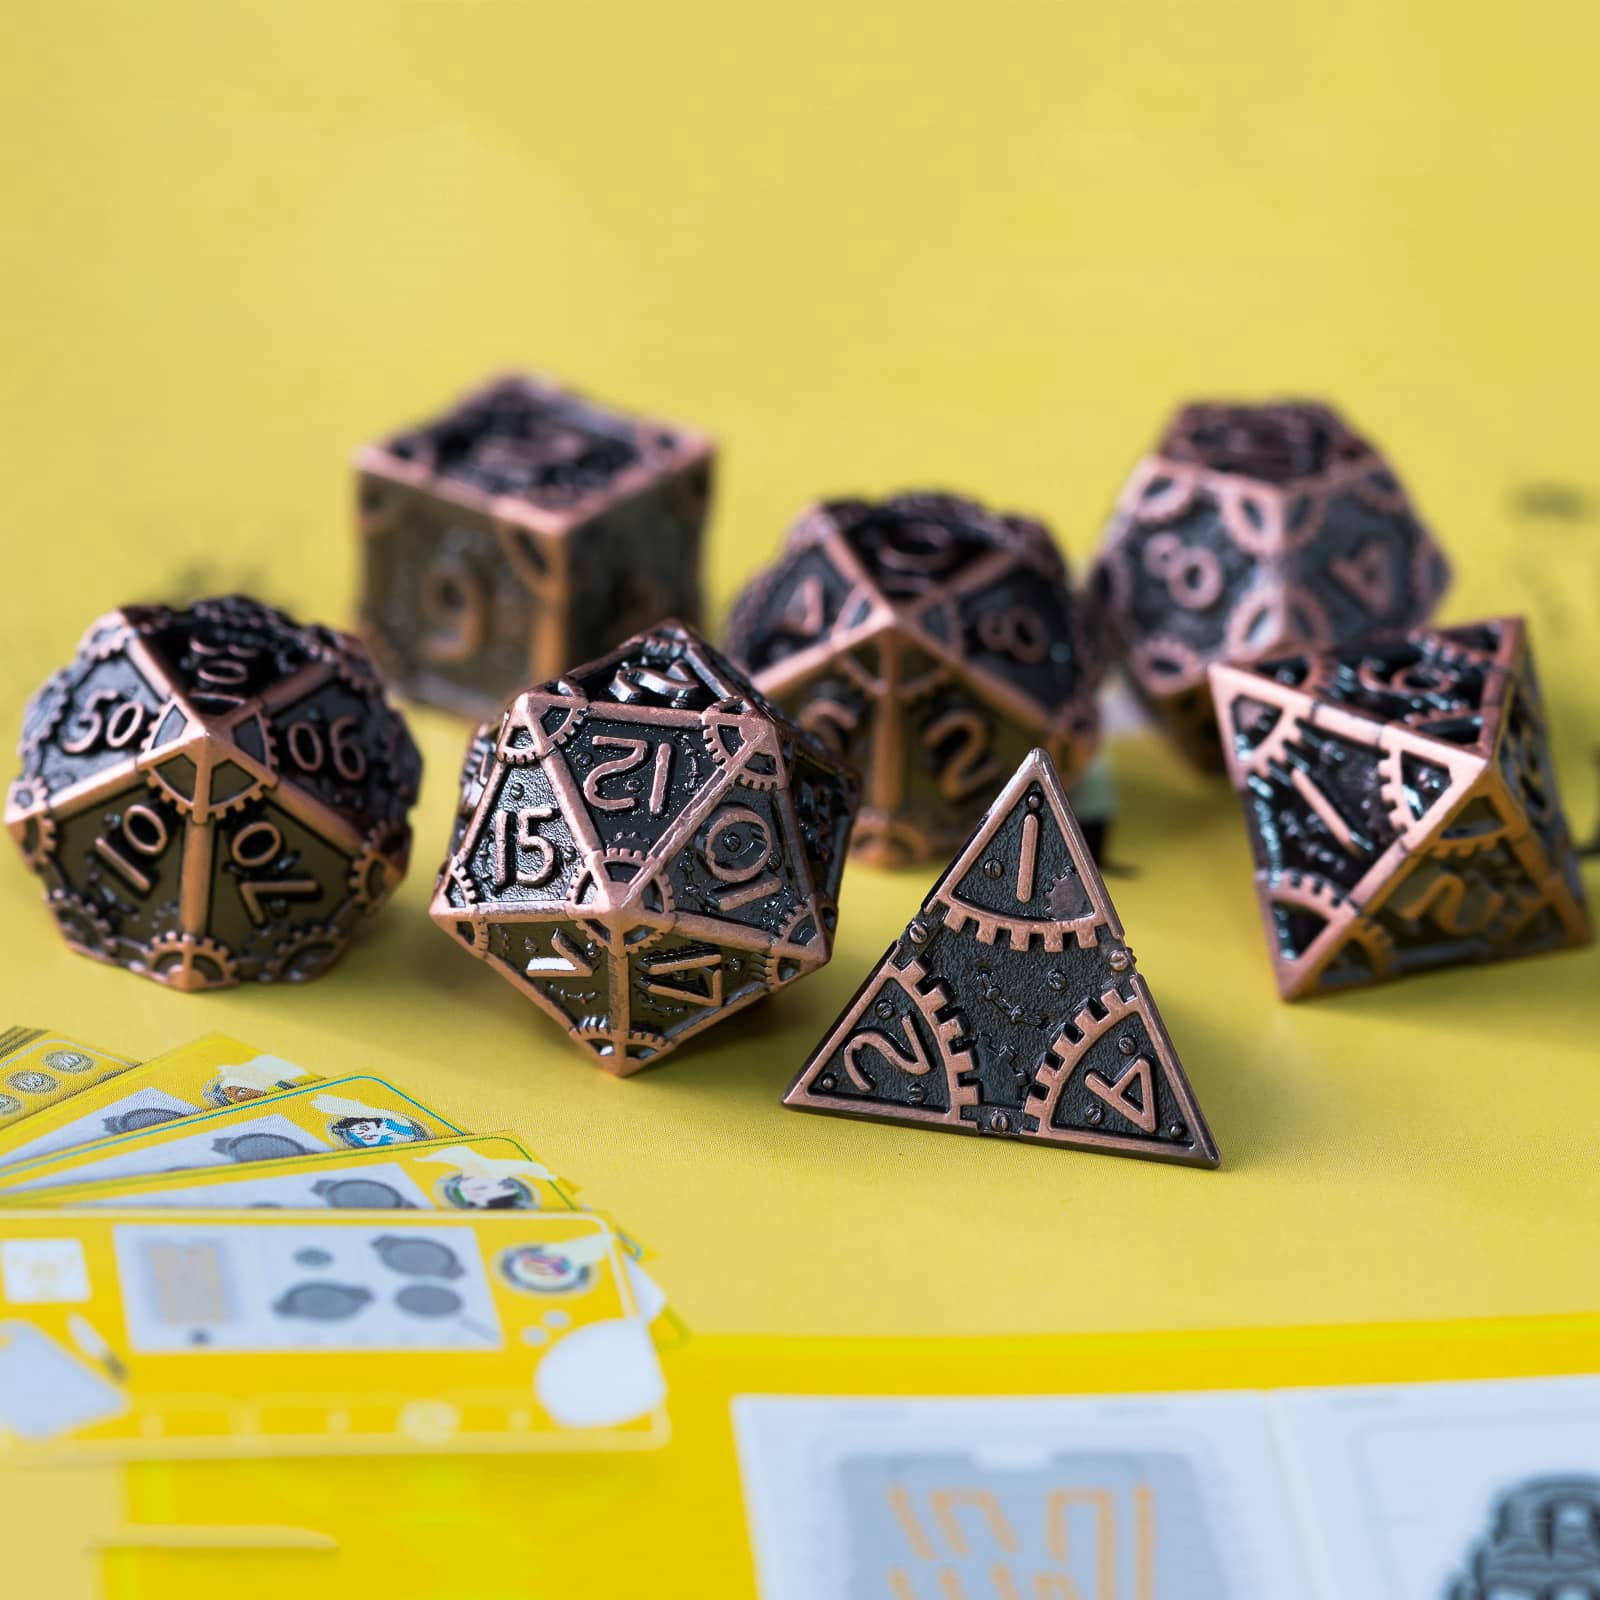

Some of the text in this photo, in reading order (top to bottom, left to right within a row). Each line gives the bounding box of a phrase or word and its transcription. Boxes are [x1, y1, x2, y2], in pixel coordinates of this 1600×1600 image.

[1143, 533, 1224, 609] 8
[977, 605, 1049, 664] 8
[62, 689, 144, 755] 50
[924, 710, 1000, 799] 2
[95, 804, 169, 892] 10
[231, 820, 318, 925] 70
[494, 806, 556, 888] 15
[1016, 813, 1038, 902] 1
[843, 1014, 933, 1093] 2
[1085, 1056, 1158, 1133] 4
